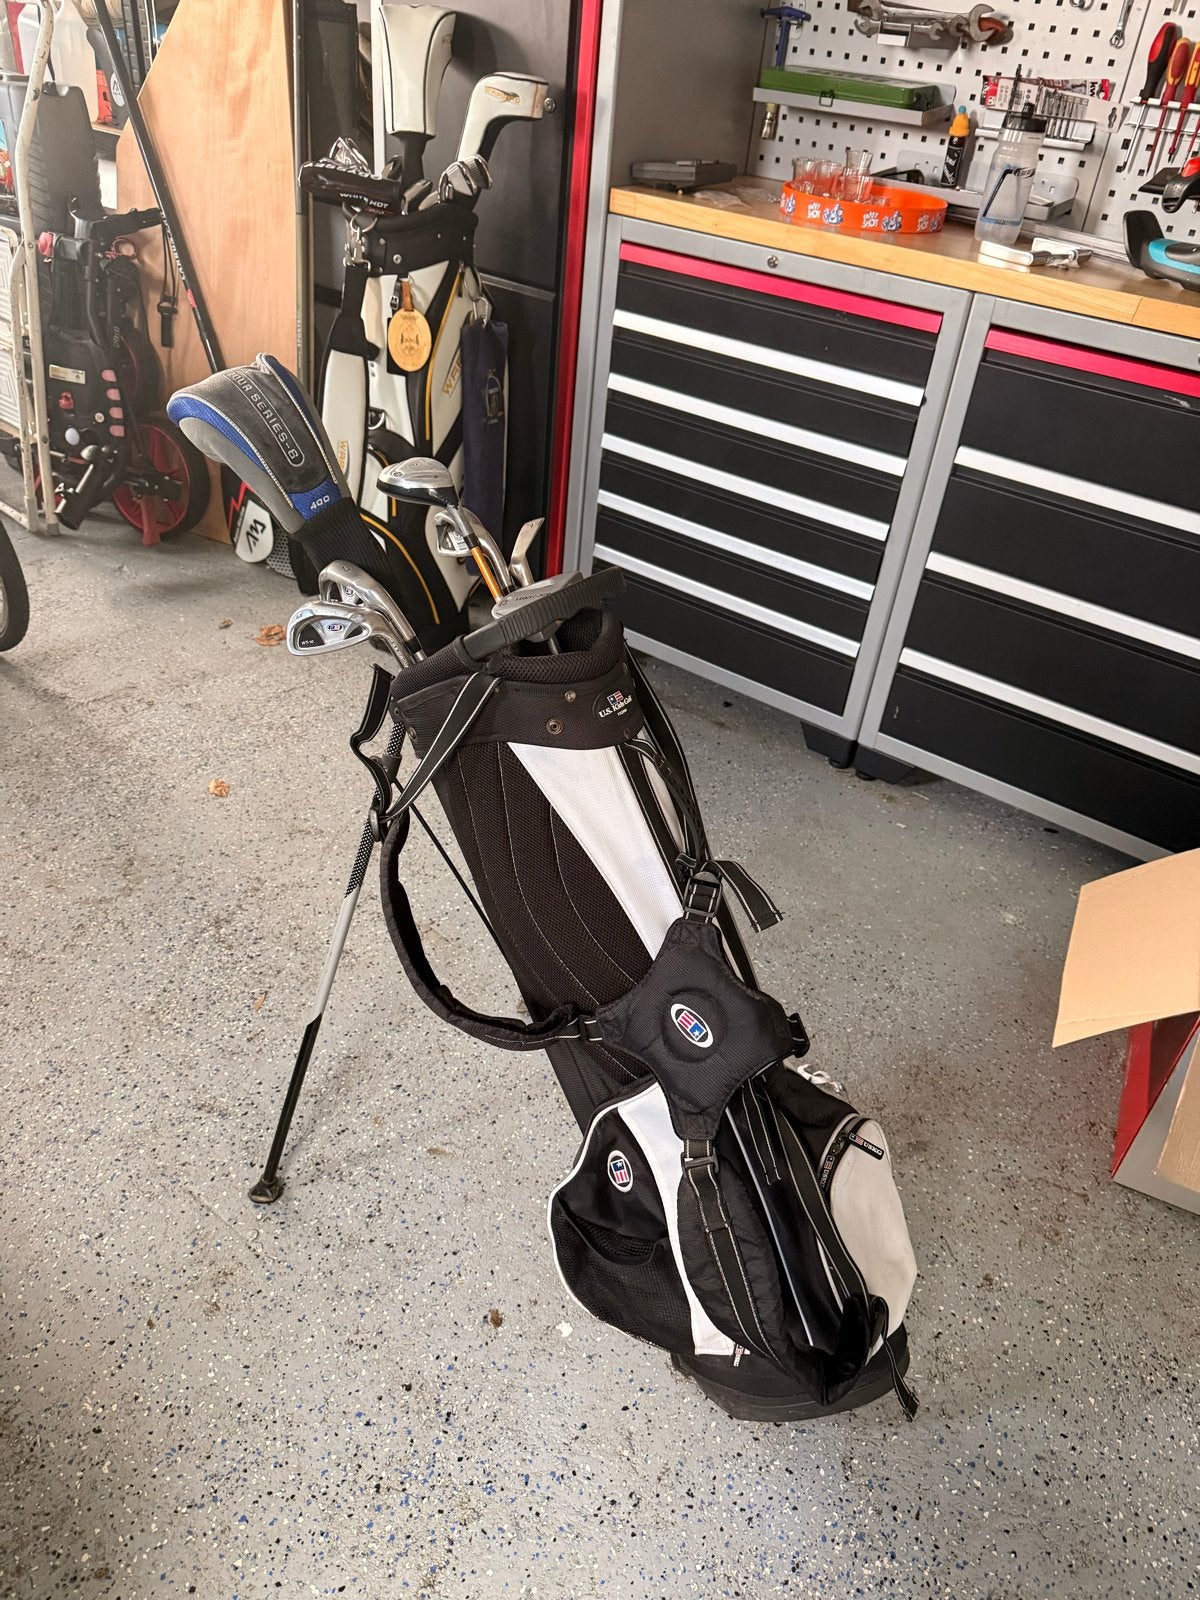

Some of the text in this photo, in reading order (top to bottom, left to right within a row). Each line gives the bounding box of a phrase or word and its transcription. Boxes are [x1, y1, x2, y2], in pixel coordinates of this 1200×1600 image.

[369, 200, 389, 209] HOT
[229, 370, 252, 392] TOUR
[311, 495, 330, 510] 400
